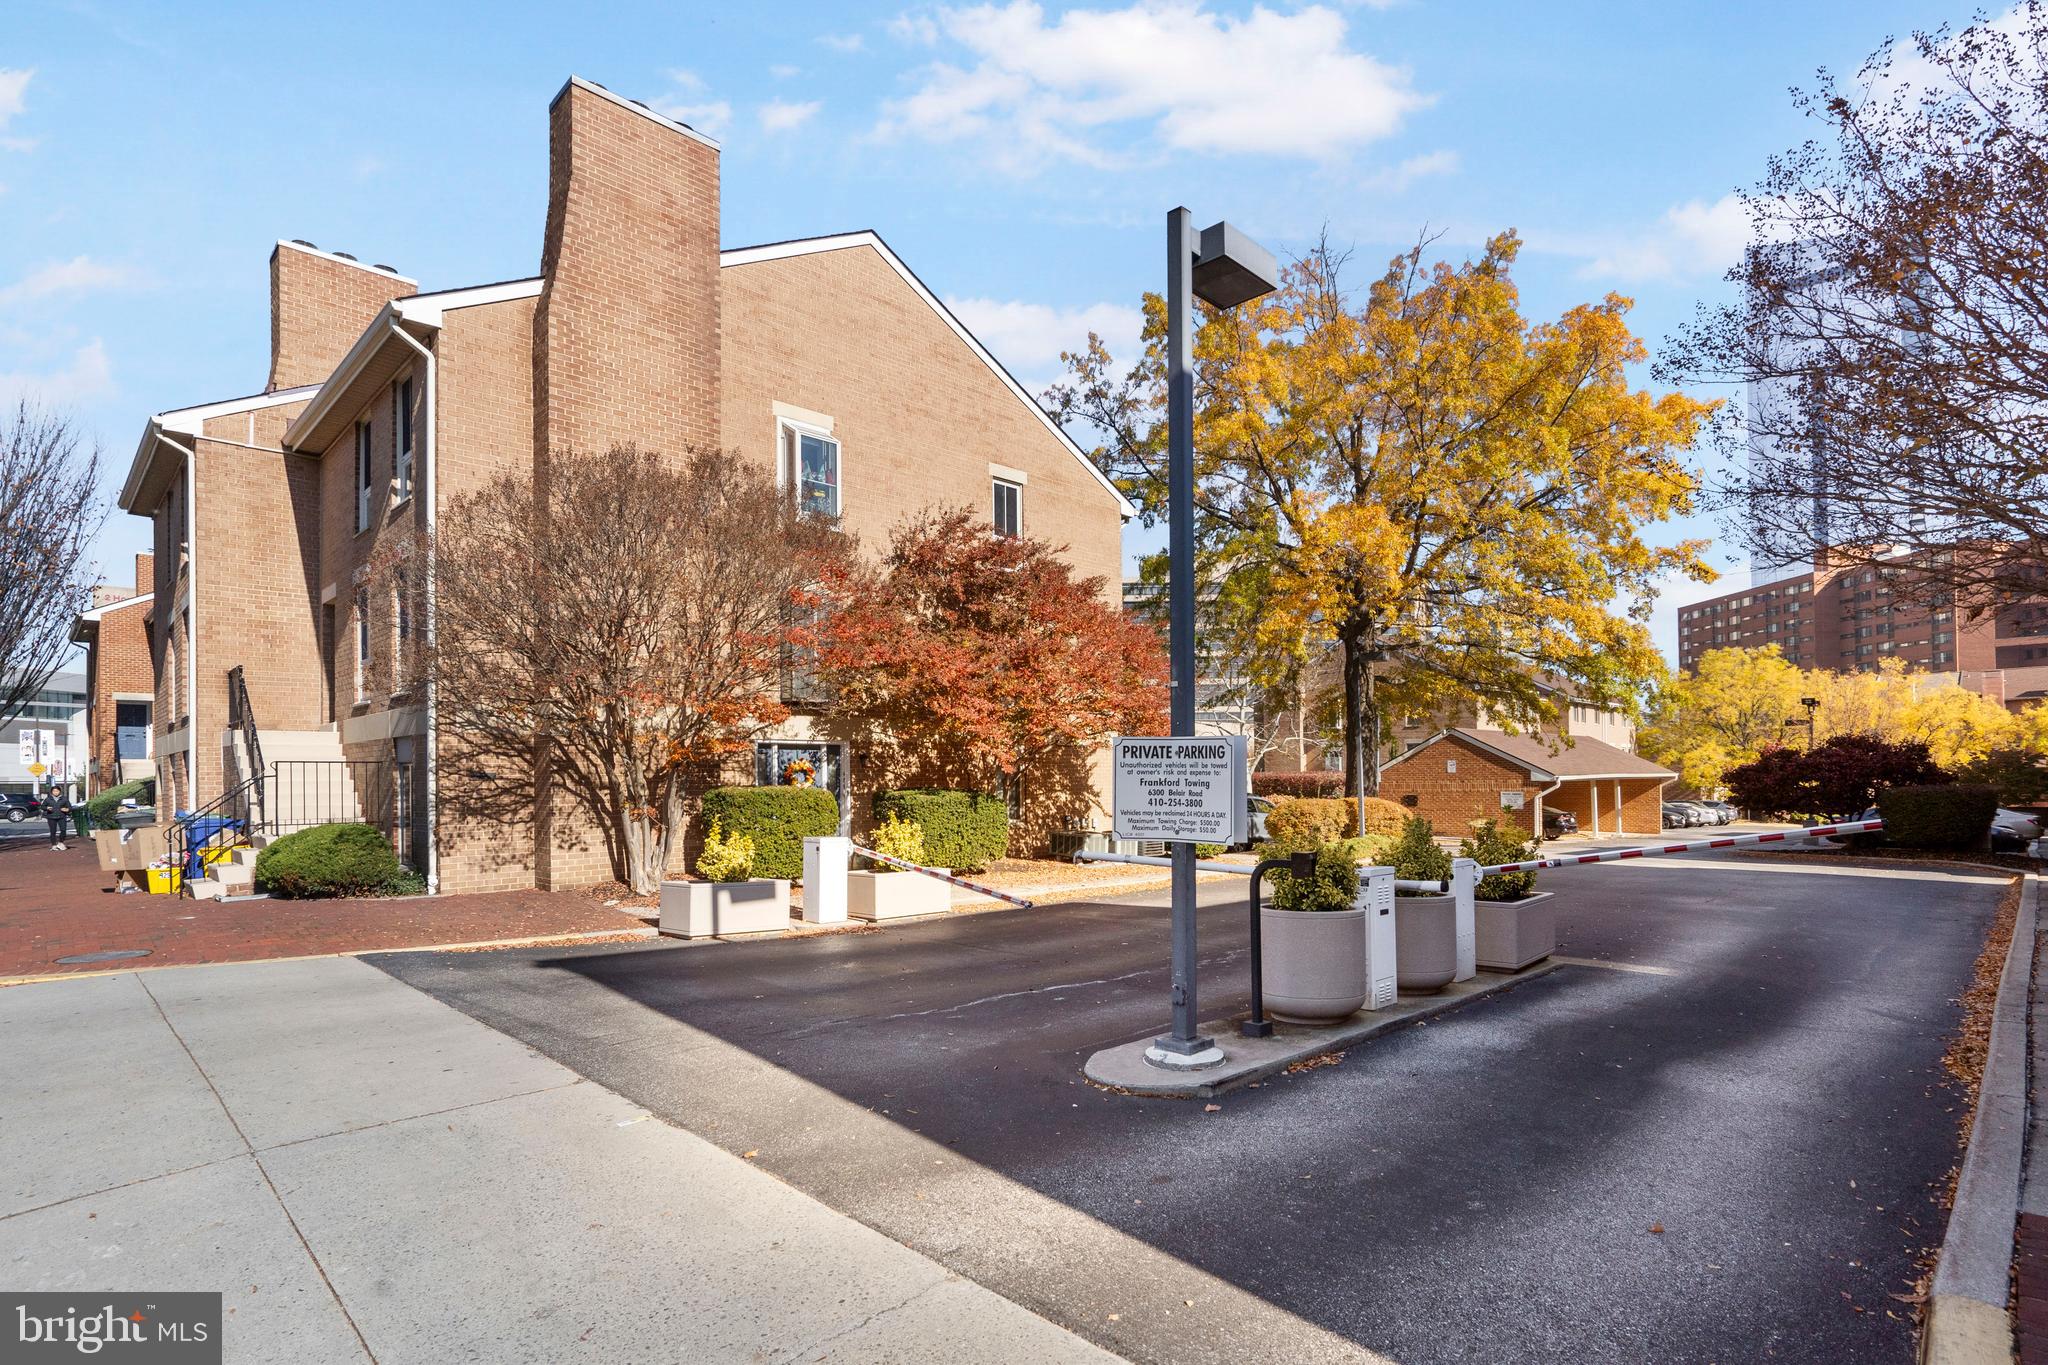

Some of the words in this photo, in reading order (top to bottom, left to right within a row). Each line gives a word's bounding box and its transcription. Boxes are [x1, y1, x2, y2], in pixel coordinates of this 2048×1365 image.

[1123, 746, 1172, 758] PRIVATE
[1178, 746, 1225, 759] PARKING
[1140, 778, 1180, 786] Frankford
[1185, 779, 1210, 789] Towing
[1148, 799, 1203, 807] 410-254-3800
